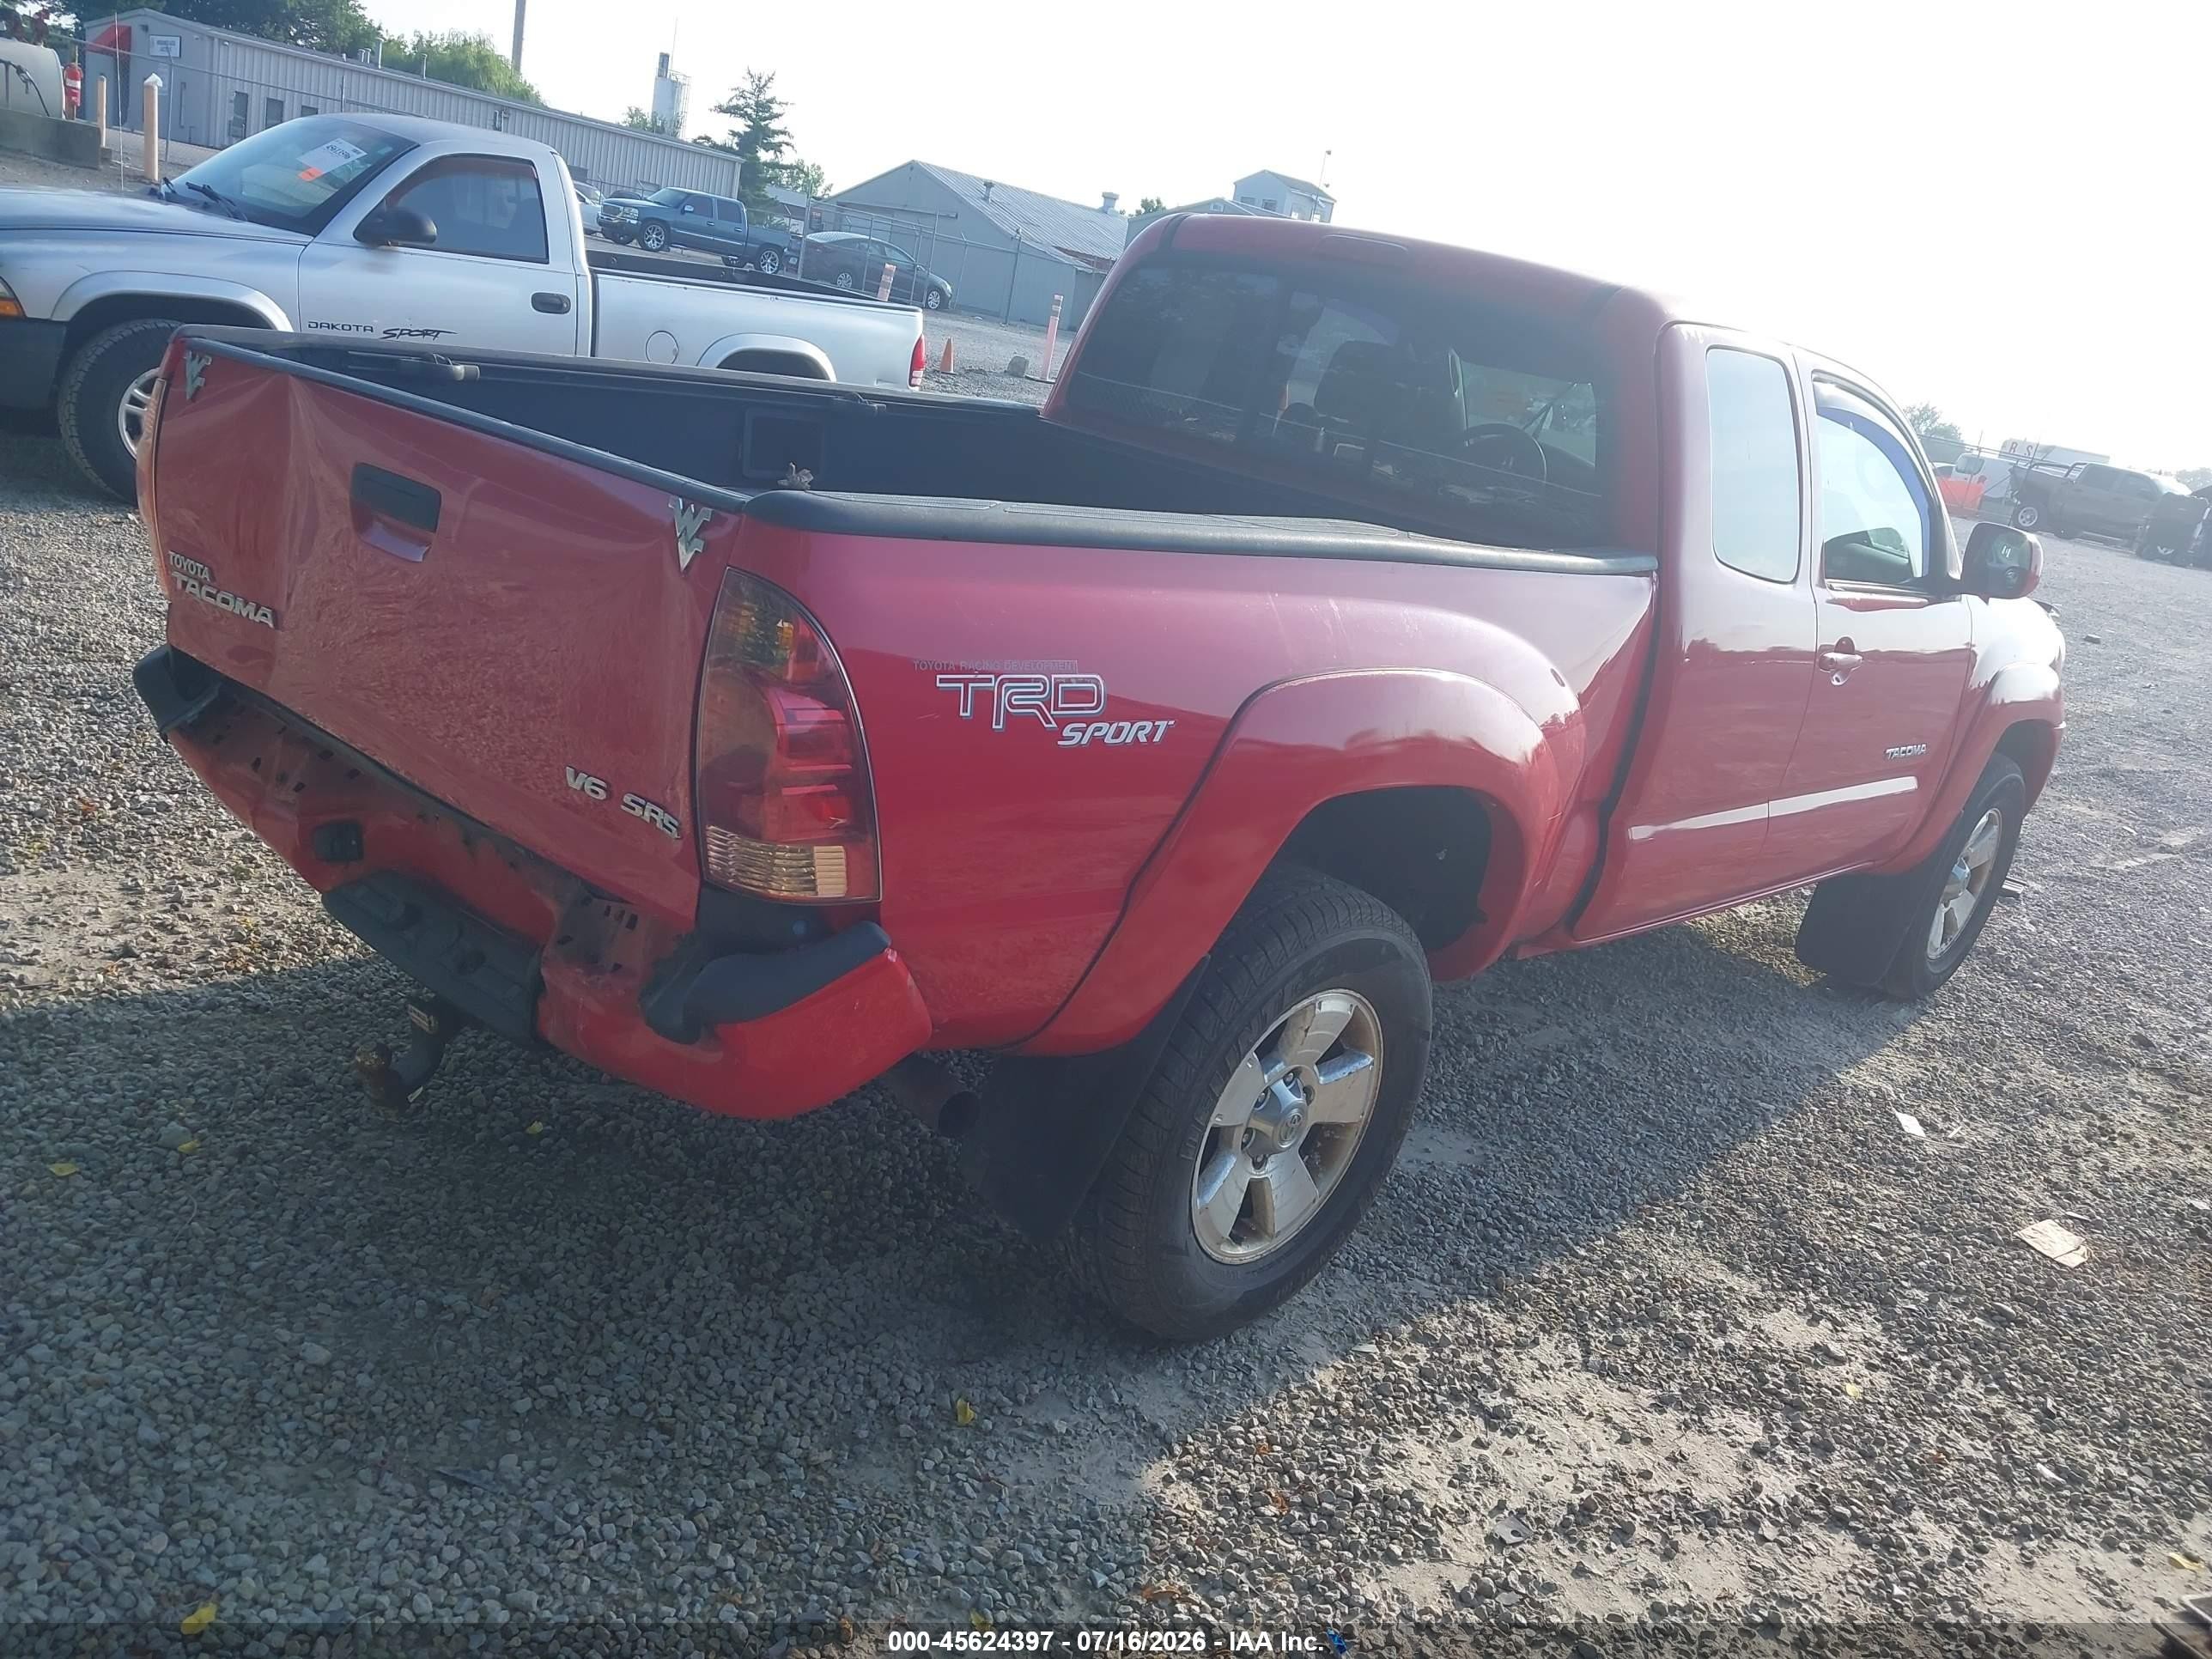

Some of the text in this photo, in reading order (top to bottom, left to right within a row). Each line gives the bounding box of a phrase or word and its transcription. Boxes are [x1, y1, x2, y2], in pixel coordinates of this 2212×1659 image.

[307, 320, 459, 341] DAKOTA SPORT
[168, 550, 211, 583] TOYOTA
[171, 570, 274, 629] TACOMA
[914, 659, 956, 671] TOYOTA
[959, 659, 1001, 671] RACING
[936, 674, 1106, 729] TRD
[1057, 720, 1176, 745] SPORT
[1884, 744, 1927, 760] TACOMA
[565, 766, 607, 800] V6
